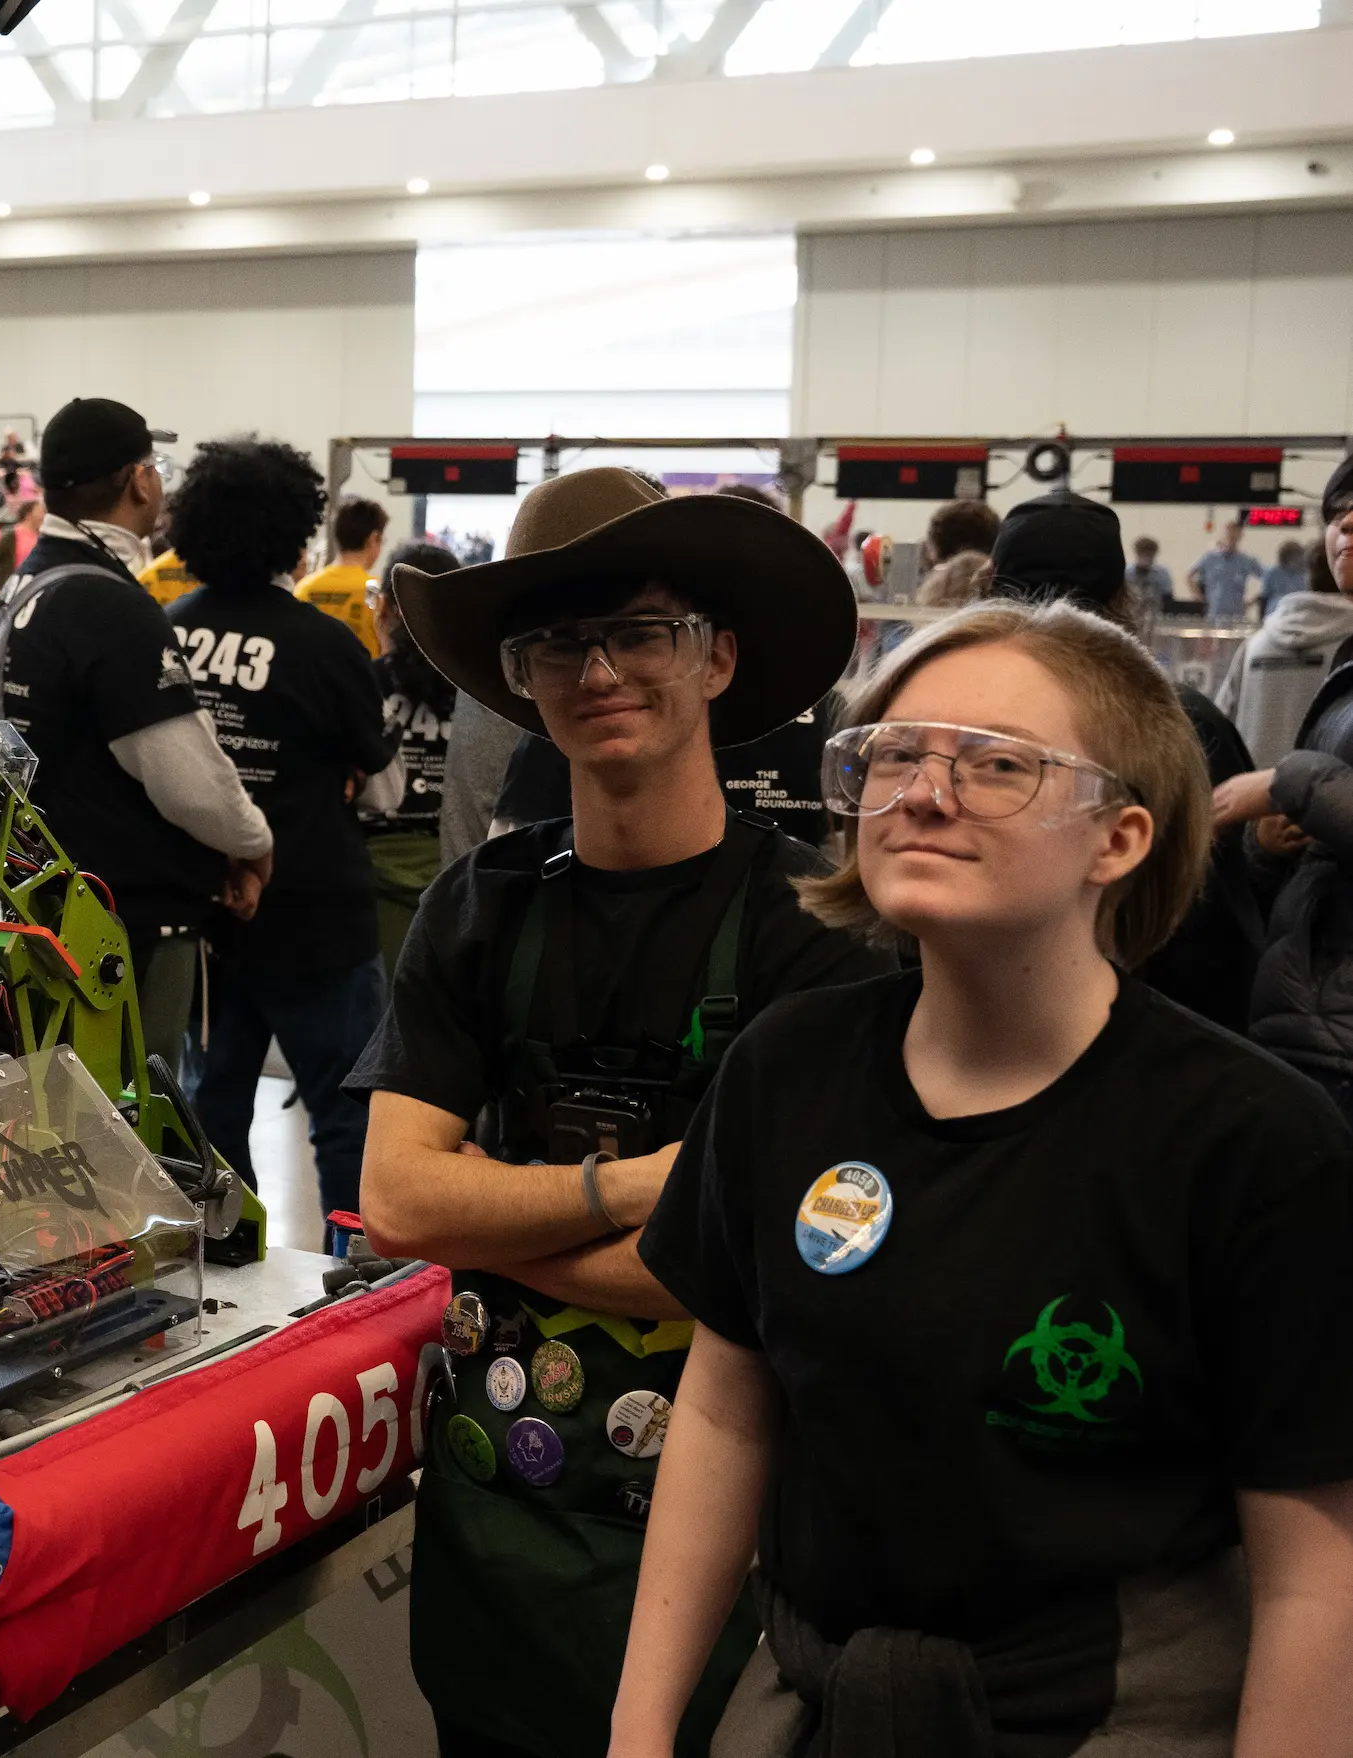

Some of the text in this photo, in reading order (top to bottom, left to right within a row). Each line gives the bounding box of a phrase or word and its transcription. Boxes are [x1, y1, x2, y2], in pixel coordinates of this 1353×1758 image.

[217, 733, 280, 751] cognizant
[756, 770, 779, 780] THE
[726, 780, 771, 790] GEORGE
[755, 790, 788, 800] GUND
[755, 799, 823, 811] FOUNDATION
[844, 1170, 875, 1191] 4050
[812, 1196, 862, 1219] CHARGED
